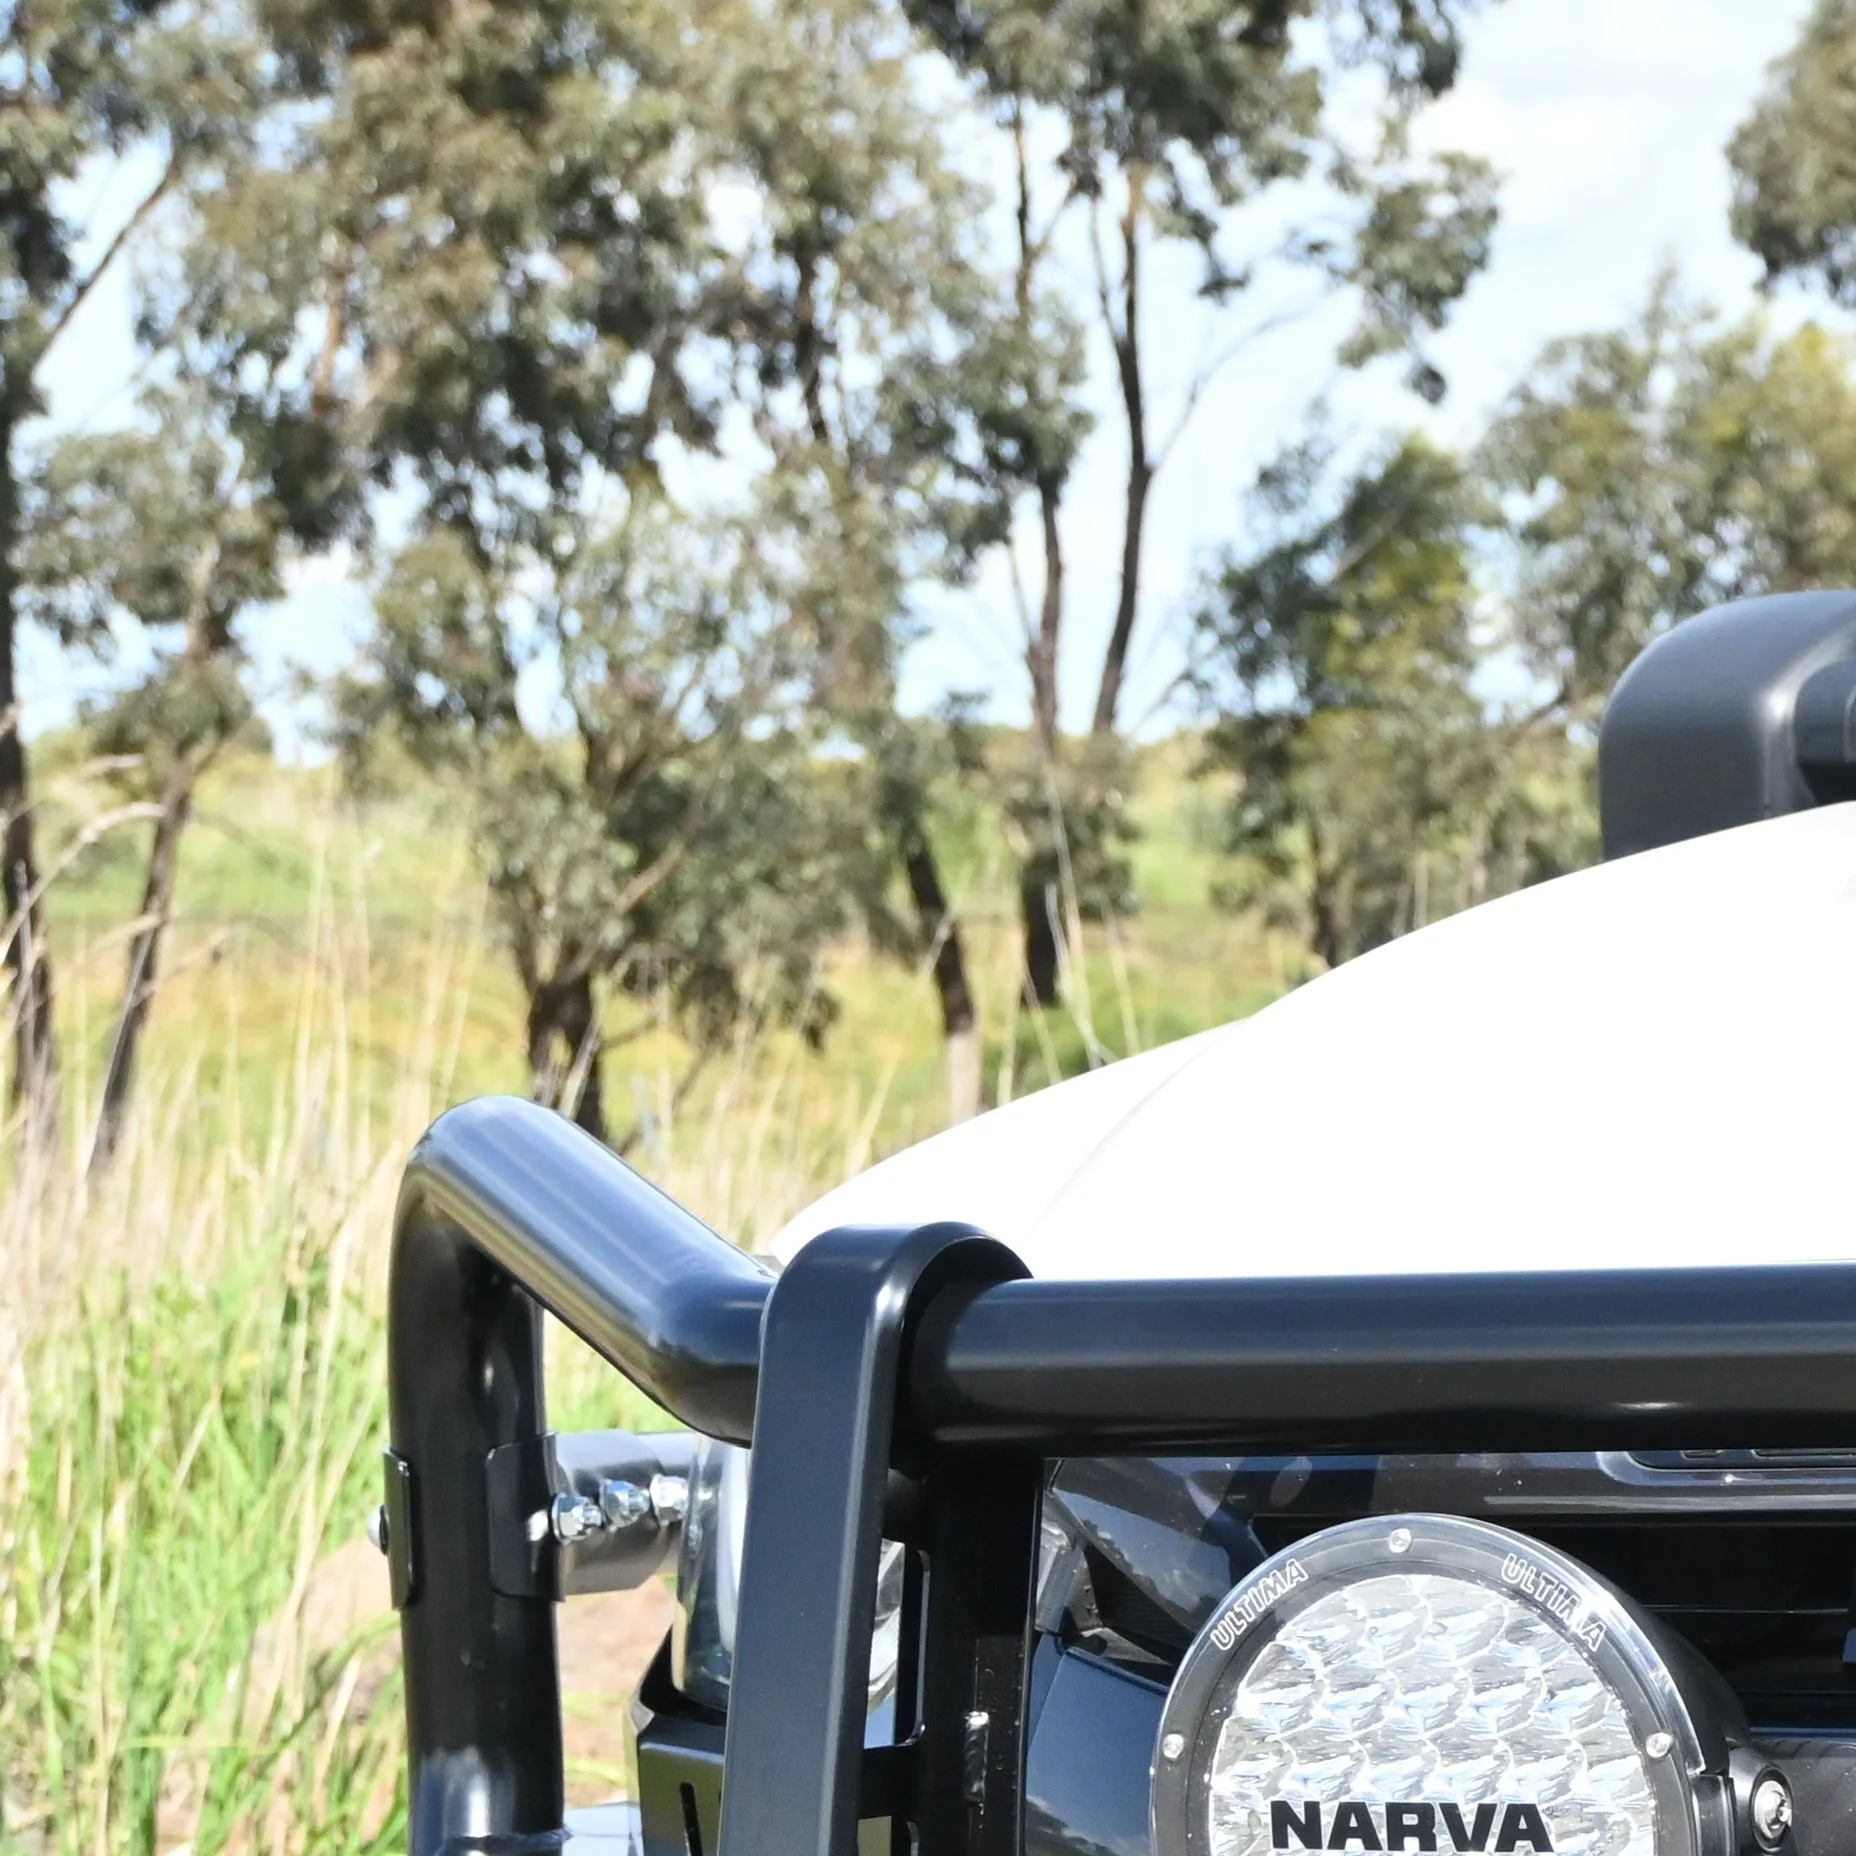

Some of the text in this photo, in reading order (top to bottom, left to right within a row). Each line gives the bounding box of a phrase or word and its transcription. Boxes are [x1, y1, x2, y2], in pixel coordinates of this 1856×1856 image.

[1211, 1558, 1309, 1651] ULTIMA
[1501, 1554, 1605, 1651] ULTIMA
[1270, 1800, 1555, 1853] NARVA
